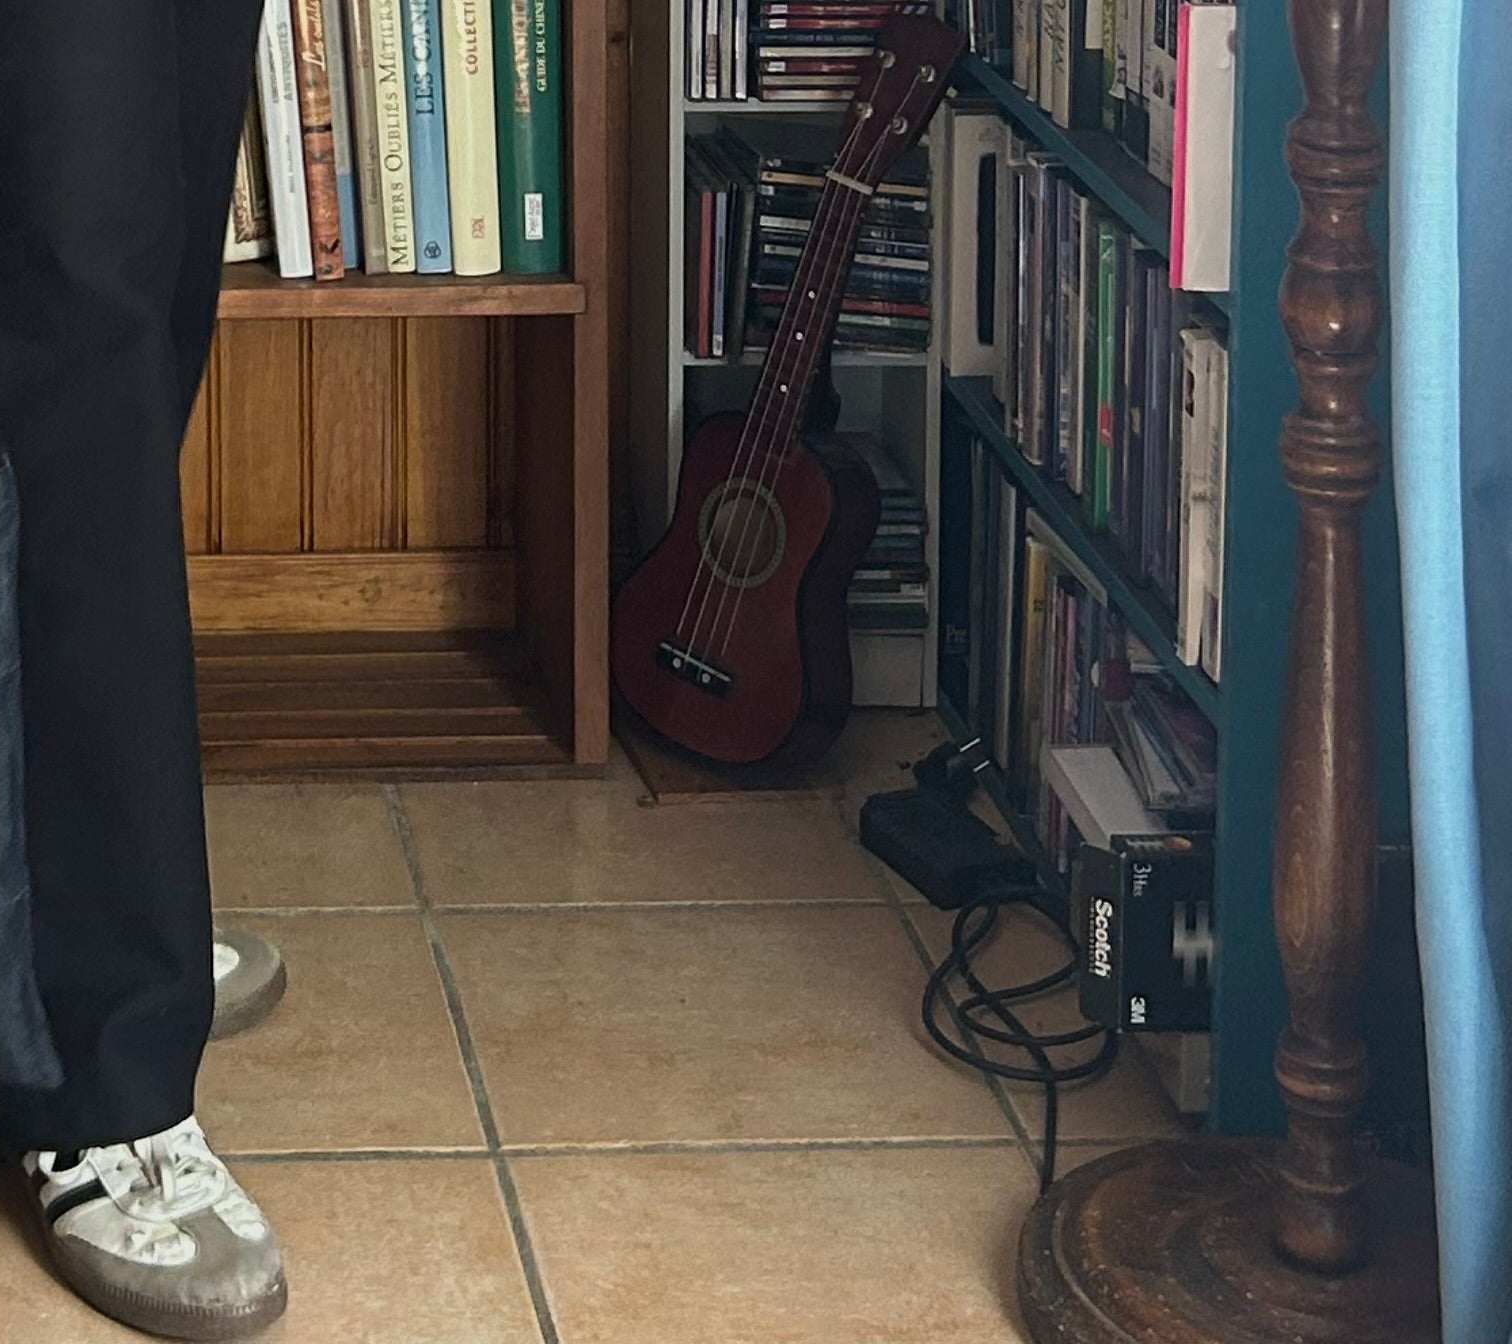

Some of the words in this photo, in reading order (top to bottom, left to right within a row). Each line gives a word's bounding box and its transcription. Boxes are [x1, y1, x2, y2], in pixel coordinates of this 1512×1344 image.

[535, 37, 546, 53] DU
[535, 54, 546, 91] GUIDE
[414, 73, 436, 116] LES
[383, 90, 403, 172] OUBLIÉS
[386, 180, 410, 268] MÉTIERS
[1093, 898, 1112, 979] Scotch
[1129, 993, 1146, 1025] 3M
